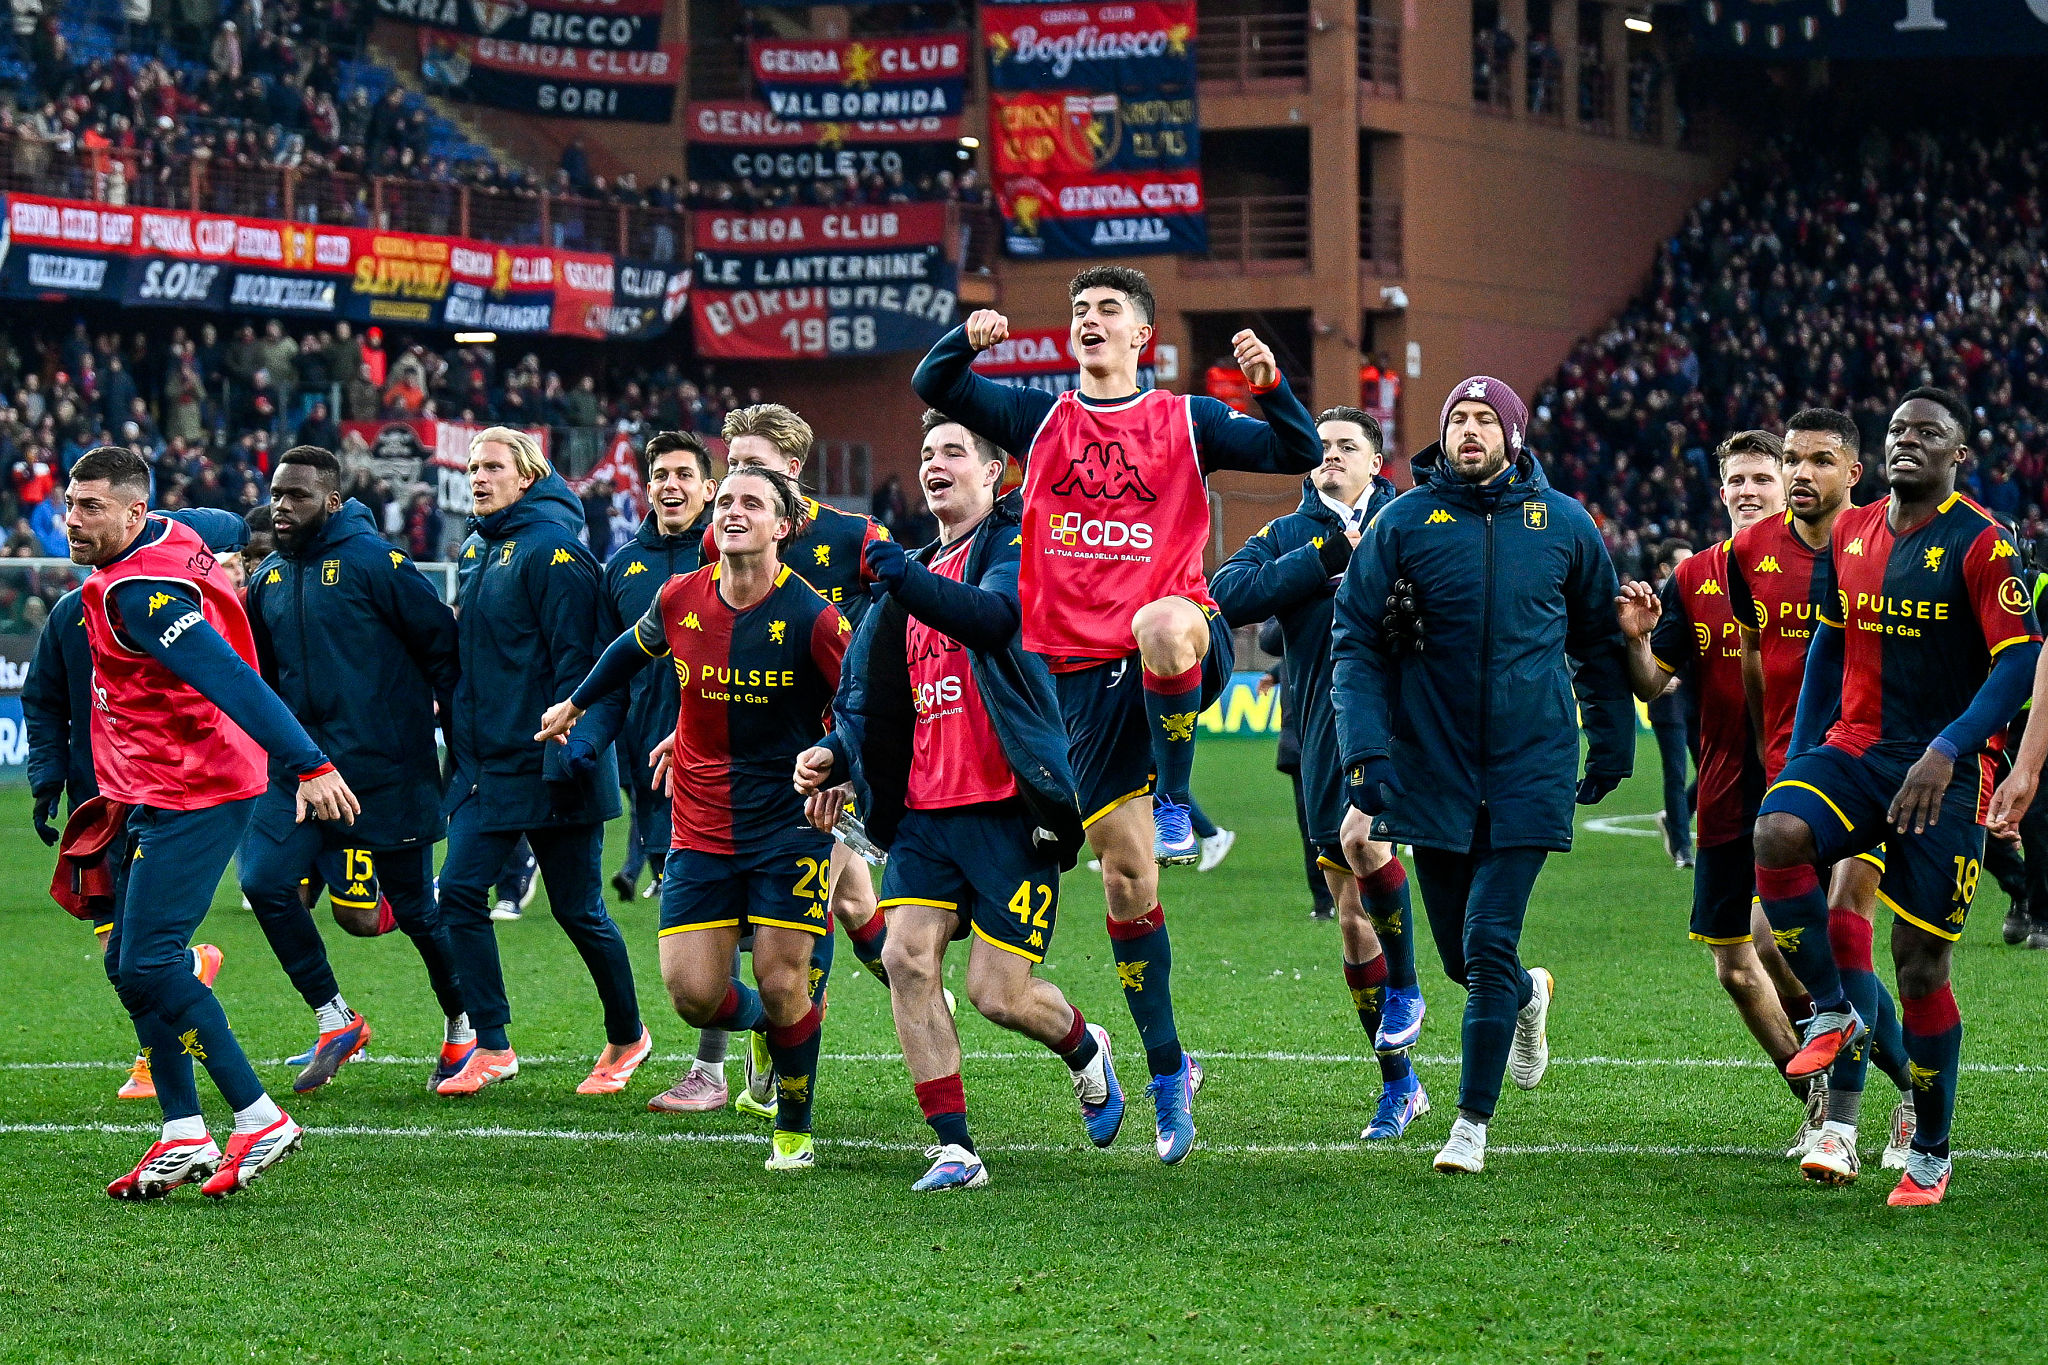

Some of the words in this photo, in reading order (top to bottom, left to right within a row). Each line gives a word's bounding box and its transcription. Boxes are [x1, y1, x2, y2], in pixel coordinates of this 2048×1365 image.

[477, 38, 578, 68] GENOA
[587, 50, 670, 75] CLUB
[760, 48, 840, 73] GENOA
[881, 44, 959, 71] CLUB
[1012, 25, 1168, 78] Bogliasco
[537, 84, 618, 114] SORI
[770, 87, 948, 117] VALBORMIDA
[732, 151, 902, 178] COGOLETO
[1060, 185, 1140, 211] GENOA
[712, 218, 804, 242] GENOA
[822, 213, 898, 239] CLUB
[705, 284, 956, 335] BORDIGHERA
[781, 316, 876, 351] 1968
[1082, 519, 1153, 549] CDS
[1057, 549, 1072, 557] TUA
[1121, 554, 1152, 563] SALUTE
[1857, 593, 1949, 621] PULSEE
[159, 611, 204, 648] HOWDEN
[1780, 626, 1810, 638] Luce
[1857, 618, 1884, 634] Luce
[1887, 625, 1894, 635] e
[1898, 626, 1922, 638] Gas
[1722, 646, 1743, 657] Luc
[702, 665, 794, 687] PULSEE
[701, 688, 730, 701] Luce
[734, 694, 741, 702] e
[745, 693, 769, 704] Gas
[343, 848, 373, 881] 15
[792, 856, 830, 901] 29
[1953, 855, 1980, 904] 18
[1008, 880, 1052, 929] 42
